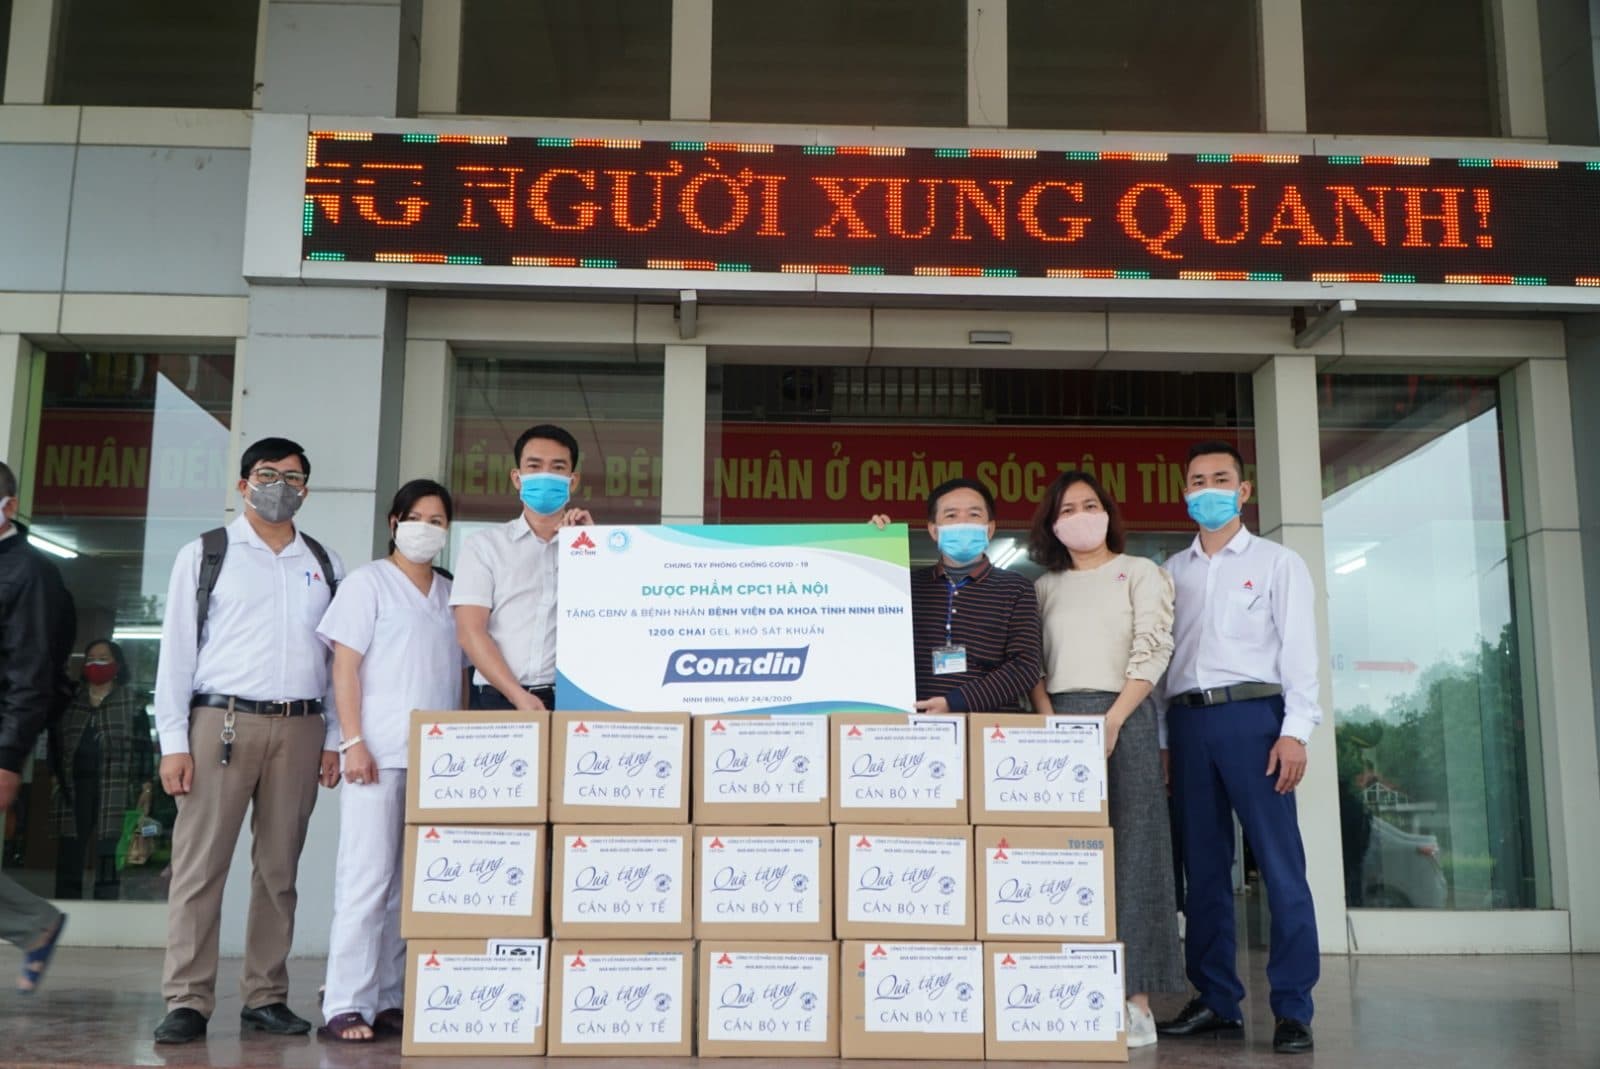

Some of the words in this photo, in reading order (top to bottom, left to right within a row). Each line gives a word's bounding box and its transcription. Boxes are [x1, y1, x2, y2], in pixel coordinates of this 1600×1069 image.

[457, 156, 786, 237] NGƯỜI
[811, 176, 1092, 243] XUNG
[1116, 182, 1494, 260] QUANH!
[43, 437, 149, 488] NHÂN
[714, 448, 813, 499] NHÂN
[825, 441, 851, 500] Ở
[860, 451, 964, 501] CHĂM
[976, 452, 1046, 503] SÓC
[709, 560, 737, 569] PHÒNG
[739, 560, 767, 568] CHỐNG
[641, 585, 685, 598] DƯỢC
[690, 579, 733, 596] PHẨM
[737, 584, 773, 596] CPC1
[776, 581, 798, 595] HÀ
[802, 581, 829, 597] NỘI
[598, 609, 628, 618] CBNV
[630, 609, 638, 617] &
[641, 607, 671, 618] BỆNH
[673, 607, 705, 617] NHÂN
[708, 607, 738, 618] BỆNH
[740, 606, 766, 617] VIỆN
[769, 607, 784, 615] ĐA
[787, 607, 818, 615] KHOA
[848, 606, 875, 615] NINH
[878, 604, 904, 615] BÌNH
[649, 628, 675, 637] 1200
[678, 628, 706, 636] CHAI
[709, 628, 731, 636] GEL
[761, 626, 782, 635] SÁT
[674, 651, 801, 677] Conadin
[751, 695, 793, 703] 24/4/2020
[427, 753, 465, 780] Quà
[474, 750, 507, 778] tặng
[572, 751, 610, 777] Quà
[618, 750, 651, 778] tặng
[711, 748, 748, 774] Quà
[756, 746, 789, 774] tặng
[847, 753, 884, 780] Quà
[893, 751, 926, 778] tặng
[991, 756, 1028, 783] Quà
[1036, 754, 1069, 782] tặng
[434, 786, 463, 800] CÁN
[470, 785, 487, 800] BỘ
[493, 787, 501, 798] Y
[507, 782, 522, 798] TẾ
[578, 784, 607, 798] CÁN
[614, 784, 631, 799] BỘ
[636, 787, 644, 798] Y
[650, 783, 666, 799] TẾ
[718, 781, 747, 795] CÁN
[753, 780, 770, 795] BỘ
[776, 782, 784, 794] Y
[789, 778, 805, 794] TẾ
[855, 786, 883, 800] CÁN
[890, 786, 907, 800] BỘ
[912, 788, 920, 799] Y
[926, 783, 942, 799] TẾ
[999, 789, 1028, 803] CÁN
[1034, 789, 1051, 804] BỘ
[1056, 792, 1064, 803] Y
[1070, 787, 1086, 802] TẾ
[423, 857, 460, 884] Quà
[470, 856, 503, 884] tặng
[571, 867, 608, 893] Quà
[618, 864, 651, 892] tặng
[709, 867, 746, 893] Quà
[755, 864, 788, 892] tặng
[856, 866, 893, 893] Quà
[902, 865, 935, 893] tặng
[428, 891, 457, 905] CÁN
[464, 892, 481, 906] BỘ
[487, 894, 495, 906] Y
[501, 891, 516, 906] TẾ
[994, 879, 1031, 905] Quà
[1040, 877, 1073, 904] tặng
[577, 900, 606, 914] CÁN
[614, 900, 631, 915] BỘ
[636, 902, 644, 913] Y
[651, 898, 666, 913] TẾ
[716, 900, 745, 914] CÁN
[752, 900, 769, 915] BỘ
[774, 902, 782, 913] Y
[788, 898, 804, 913] TẾ
[862, 900, 891, 914] CÁN
[898, 901, 915, 915] BỘ
[921, 904, 929, 915] Y
[935, 900, 950, 915] TẾ
[1001, 912, 1030, 926] CÁN
[1037, 912, 1054, 927] BỘ
[1060, 915, 1068, 926] Y
[1074, 911, 1090, 926] TẾ
[717, 984, 754, 1010] Quà
[763, 982, 796, 1010] tặng
[872, 975, 909, 1002] Quà
[919, 973, 952, 1000] tặng
[1003, 984, 1040, 1011] Quà
[1050, 981, 1083, 1009] tặng
[424, 986, 461, 1012] Quà
[471, 983, 504, 1011] tặng
[570, 987, 607, 1013] Quà
[617, 983, 650, 1011] tặng
[723, 1018, 752, 1032] CÁN
[759, 1018, 776, 1033] BỘ
[782, 1020, 790, 1032] Y
[796, 1016, 812, 1032] TẾ
[880, 1009, 908, 1023] CÁN
[916, 1009, 933, 1024] BỘ
[939, 1011, 947, 1022] Y
[953, 1007, 968, 1022] TẾ
[1011, 1018, 1040, 1032] CÁN
[1048, 1018, 1065, 1033] BỘ
[1070, 1020, 1078, 1031] Y
[1085, 1015, 1100, 1031] TẾ
[429, 1020, 458, 1034] CÁN
[466, 1020, 483, 1034] BỘ
[489, 1022, 497, 1033] Y
[504, 1018, 519, 1033] TẾ
[577, 1020, 605, 1034] CÁN
[613, 1020, 630, 1035] BỘ
[636, 1022, 644, 1033] Y
[650, 1017, 666, 1033] TẾ
